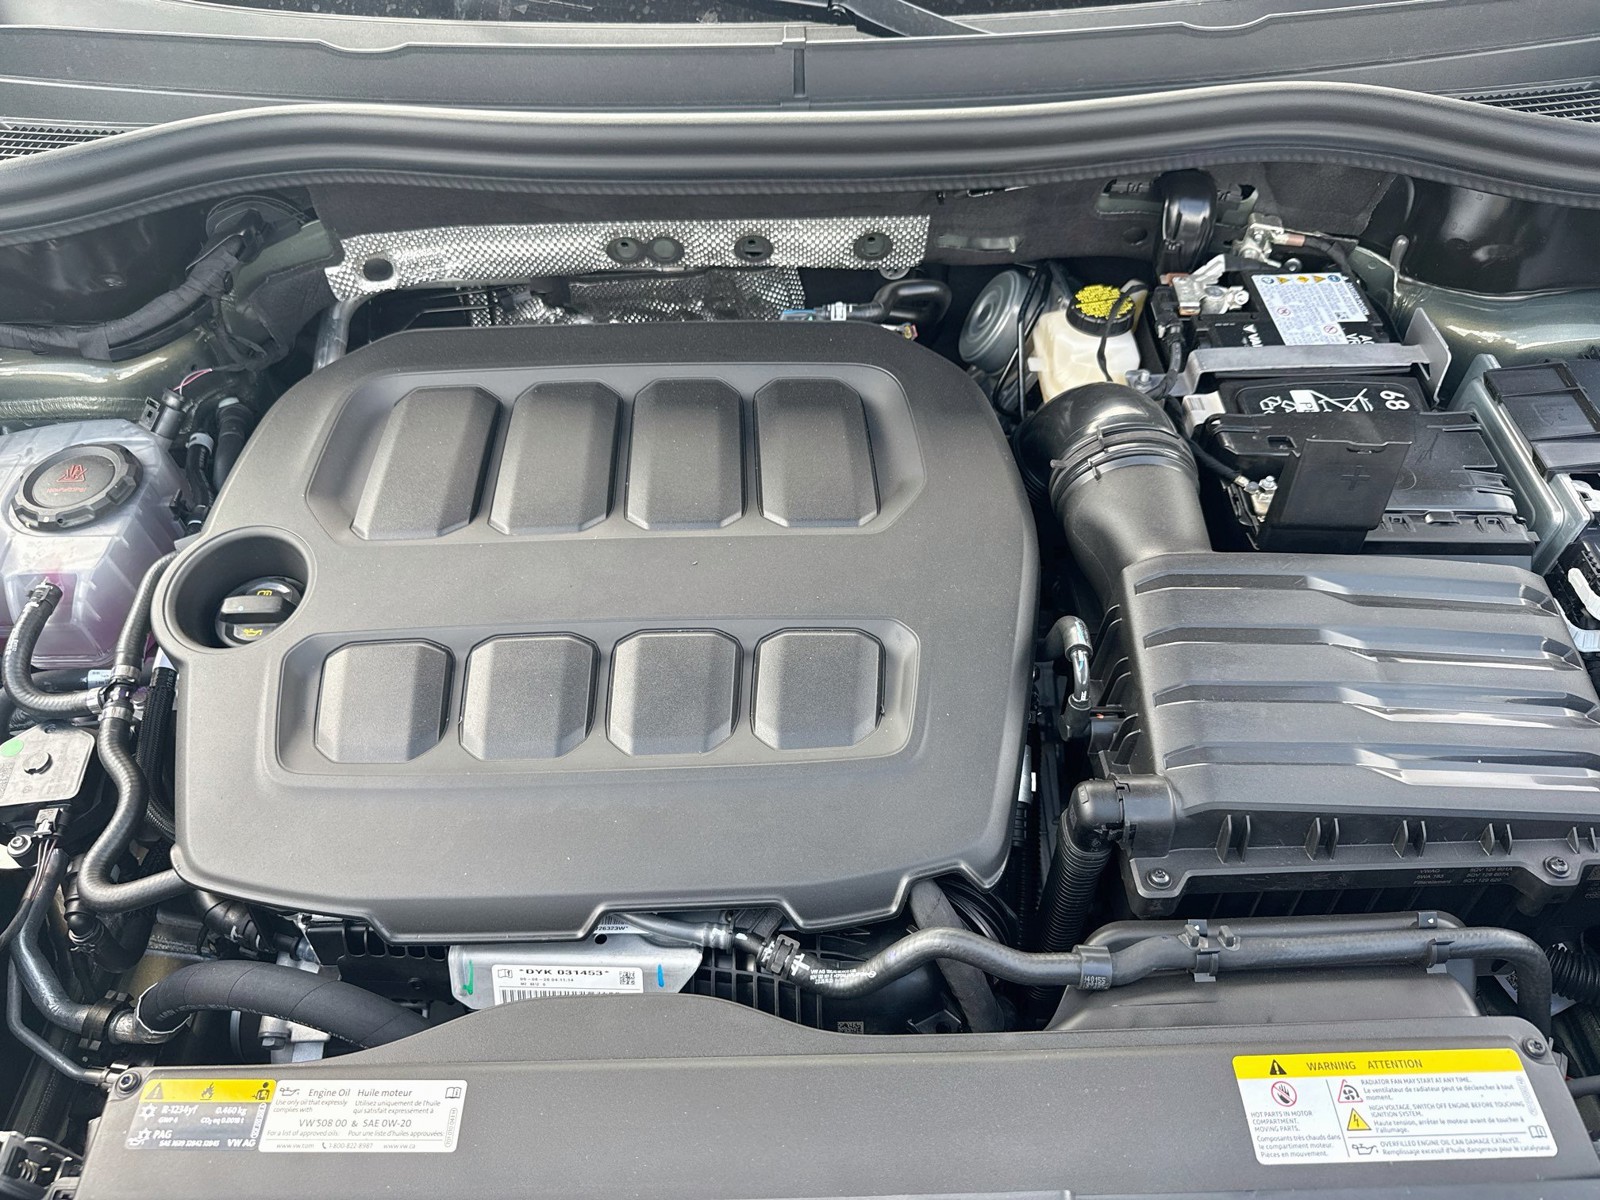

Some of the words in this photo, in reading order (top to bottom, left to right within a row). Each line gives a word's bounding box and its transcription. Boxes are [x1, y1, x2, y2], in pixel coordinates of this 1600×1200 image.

[1379, 390, 1411, 410] 68
[1306, 1061, 1356, 1071] WARNING
[1368, 1059, 1422, 1069] ATTENTION
[308, 1088, 336, 1099] Engine
[338, 1088, 350, 1096] Oil
[161, 1104, 199, 1116] R-1234yf
[238, 1106, 248, 1116] kg
[1264, 1110, 1282, 1118] PARTS
[300, 1119, 315, 1127] VW
[316, 1119, 333, 1127] 508
[335, 1119, 348, 1127] 00
[362, 1119, 380, 1128] SAE
[382, 1119, 412, 1128] 0W-20
[153, 1130, 172, 1139] PAG
[228, 1139, 242, 1147] VW
[242, 1139, 256, 1147] AG
[1266, 1142, 1308, 1150] compartiment
[1261, 1150, 1280, 1158] Pièces
[1382, 1148, 1420, 1156] Remplissage
[1467, 1146, 1498, 1154] dangereux
